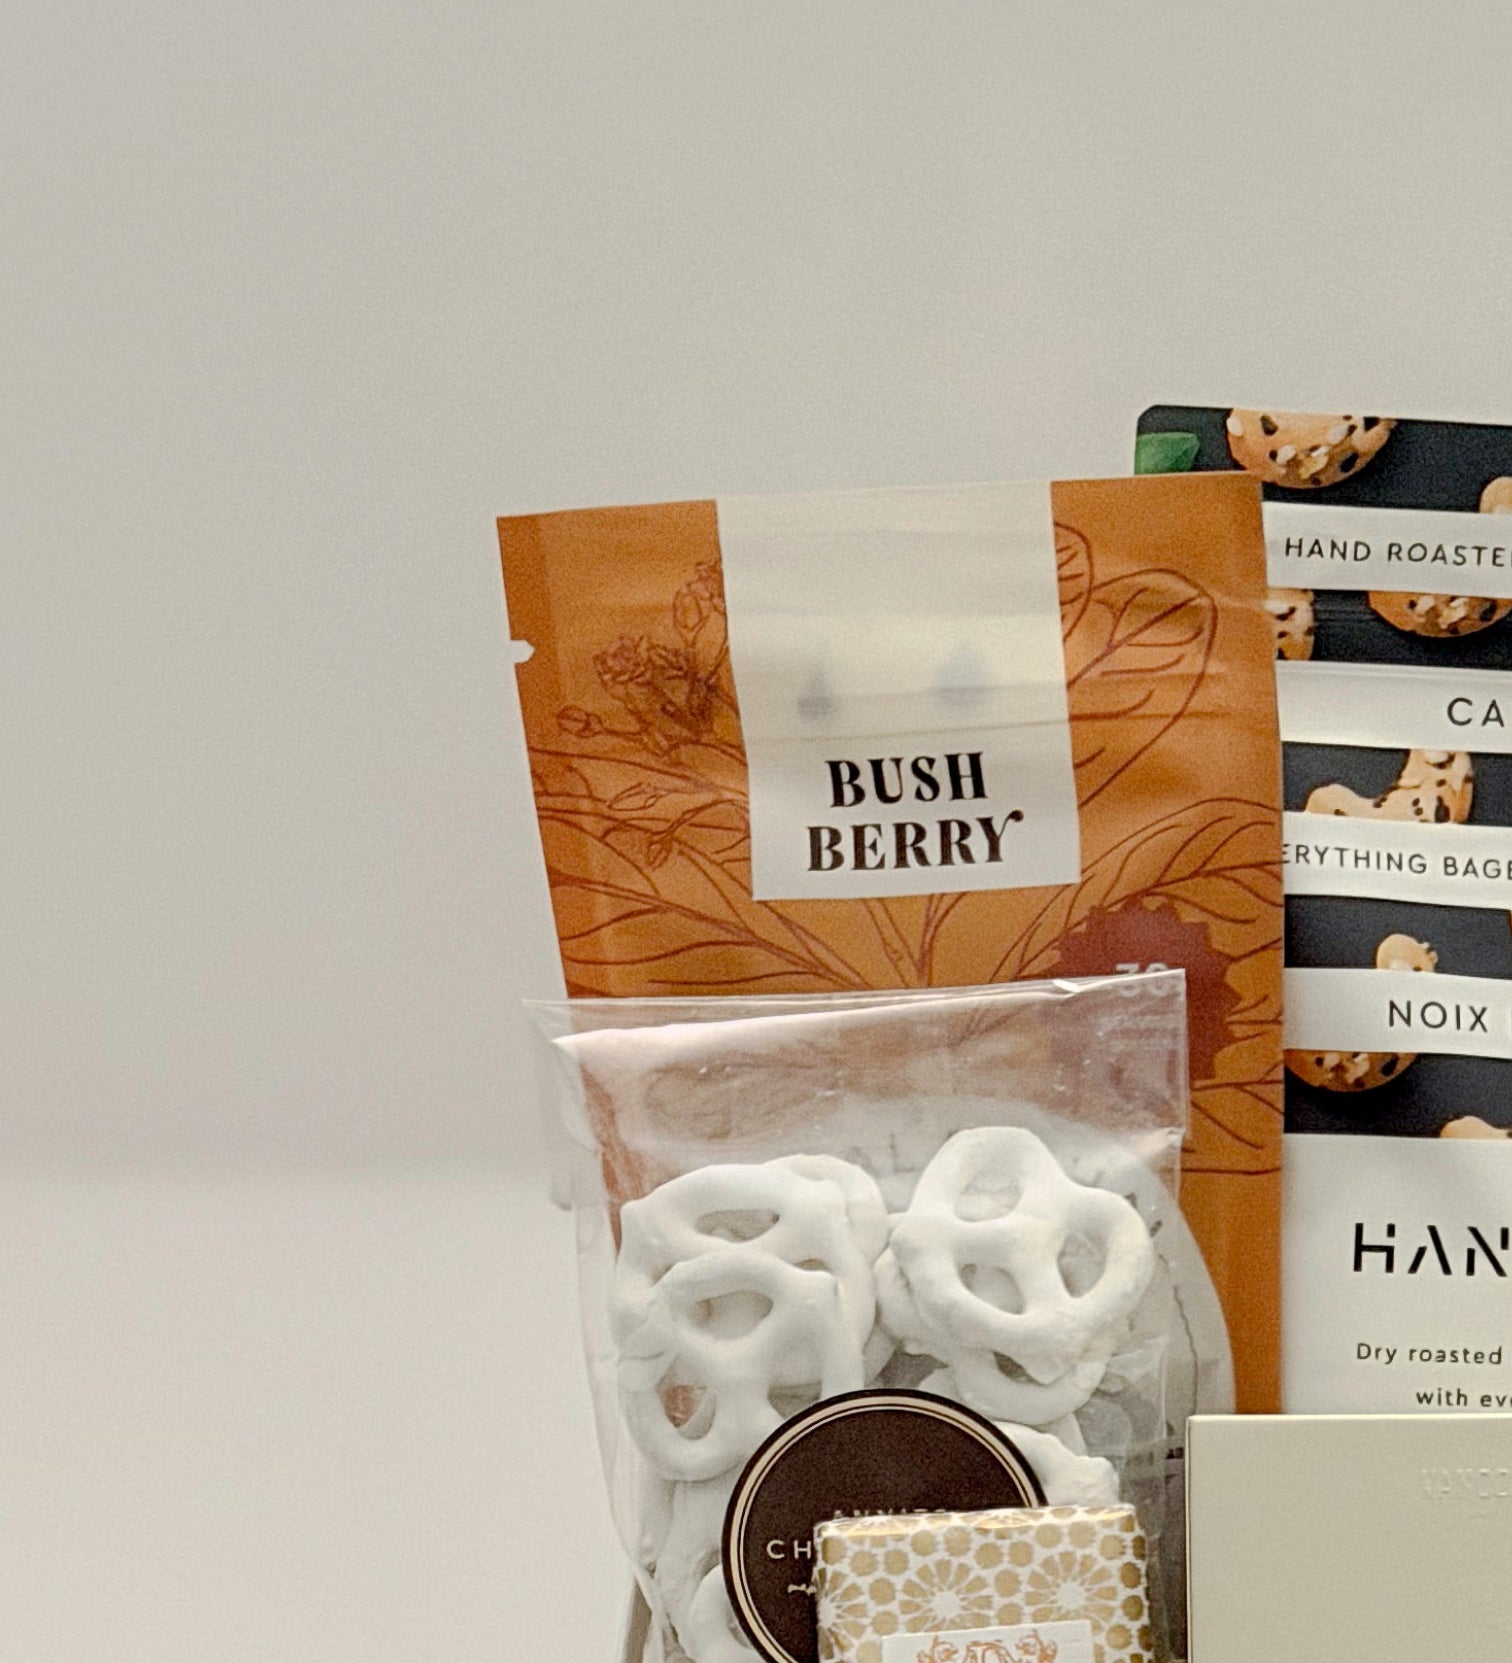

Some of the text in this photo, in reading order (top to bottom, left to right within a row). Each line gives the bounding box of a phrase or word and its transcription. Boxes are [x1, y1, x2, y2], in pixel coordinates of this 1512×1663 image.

[1285, 537, 1371, 562] HAND
[826, 752, 987, 808] BUSH
[807, 809, 1024, 871] BERRY
[1388, 1000, 1488, 1033] NOIX
[1356, 1342, 1397, 1365] Dry
[1408, 1346, 1502, 1365] roasted
[1416, 1388, 1468, 1407] with
